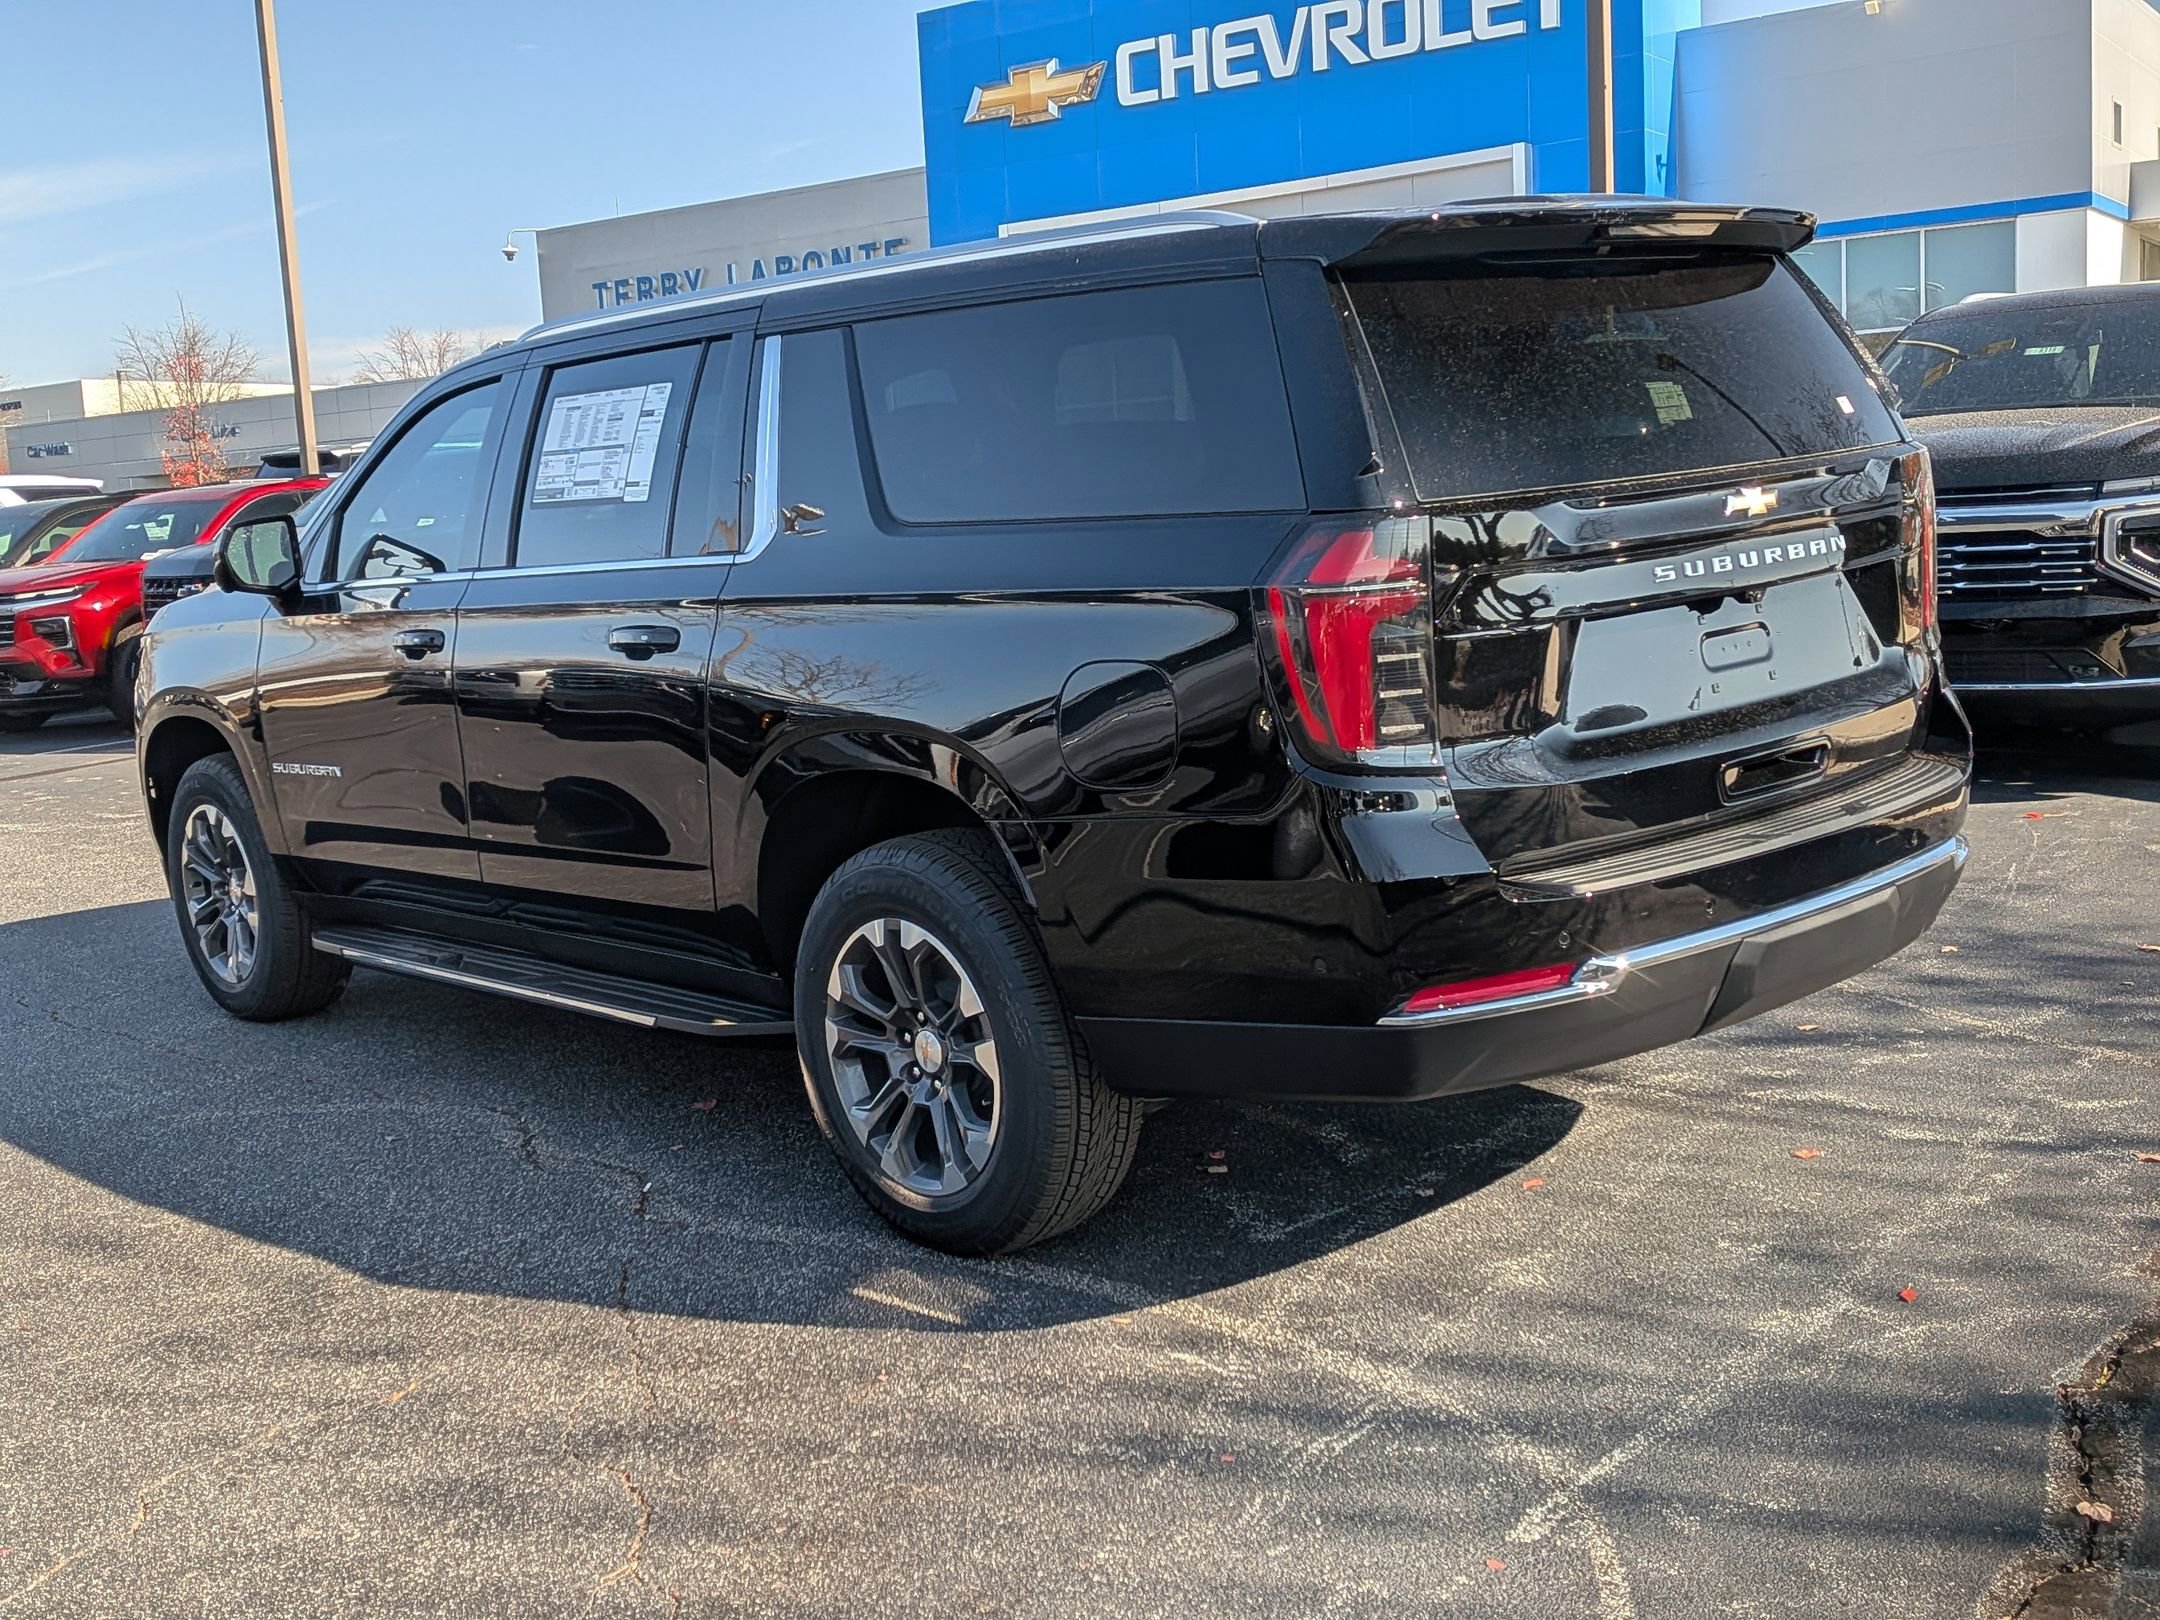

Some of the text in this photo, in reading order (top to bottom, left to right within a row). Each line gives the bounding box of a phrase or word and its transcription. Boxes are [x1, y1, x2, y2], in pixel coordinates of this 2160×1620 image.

[591, 266, 705, 310] TERRY
[1653, 533, 1847, 583] SUBURBAN
[272, 762, 342, 778] SUBURBAN
